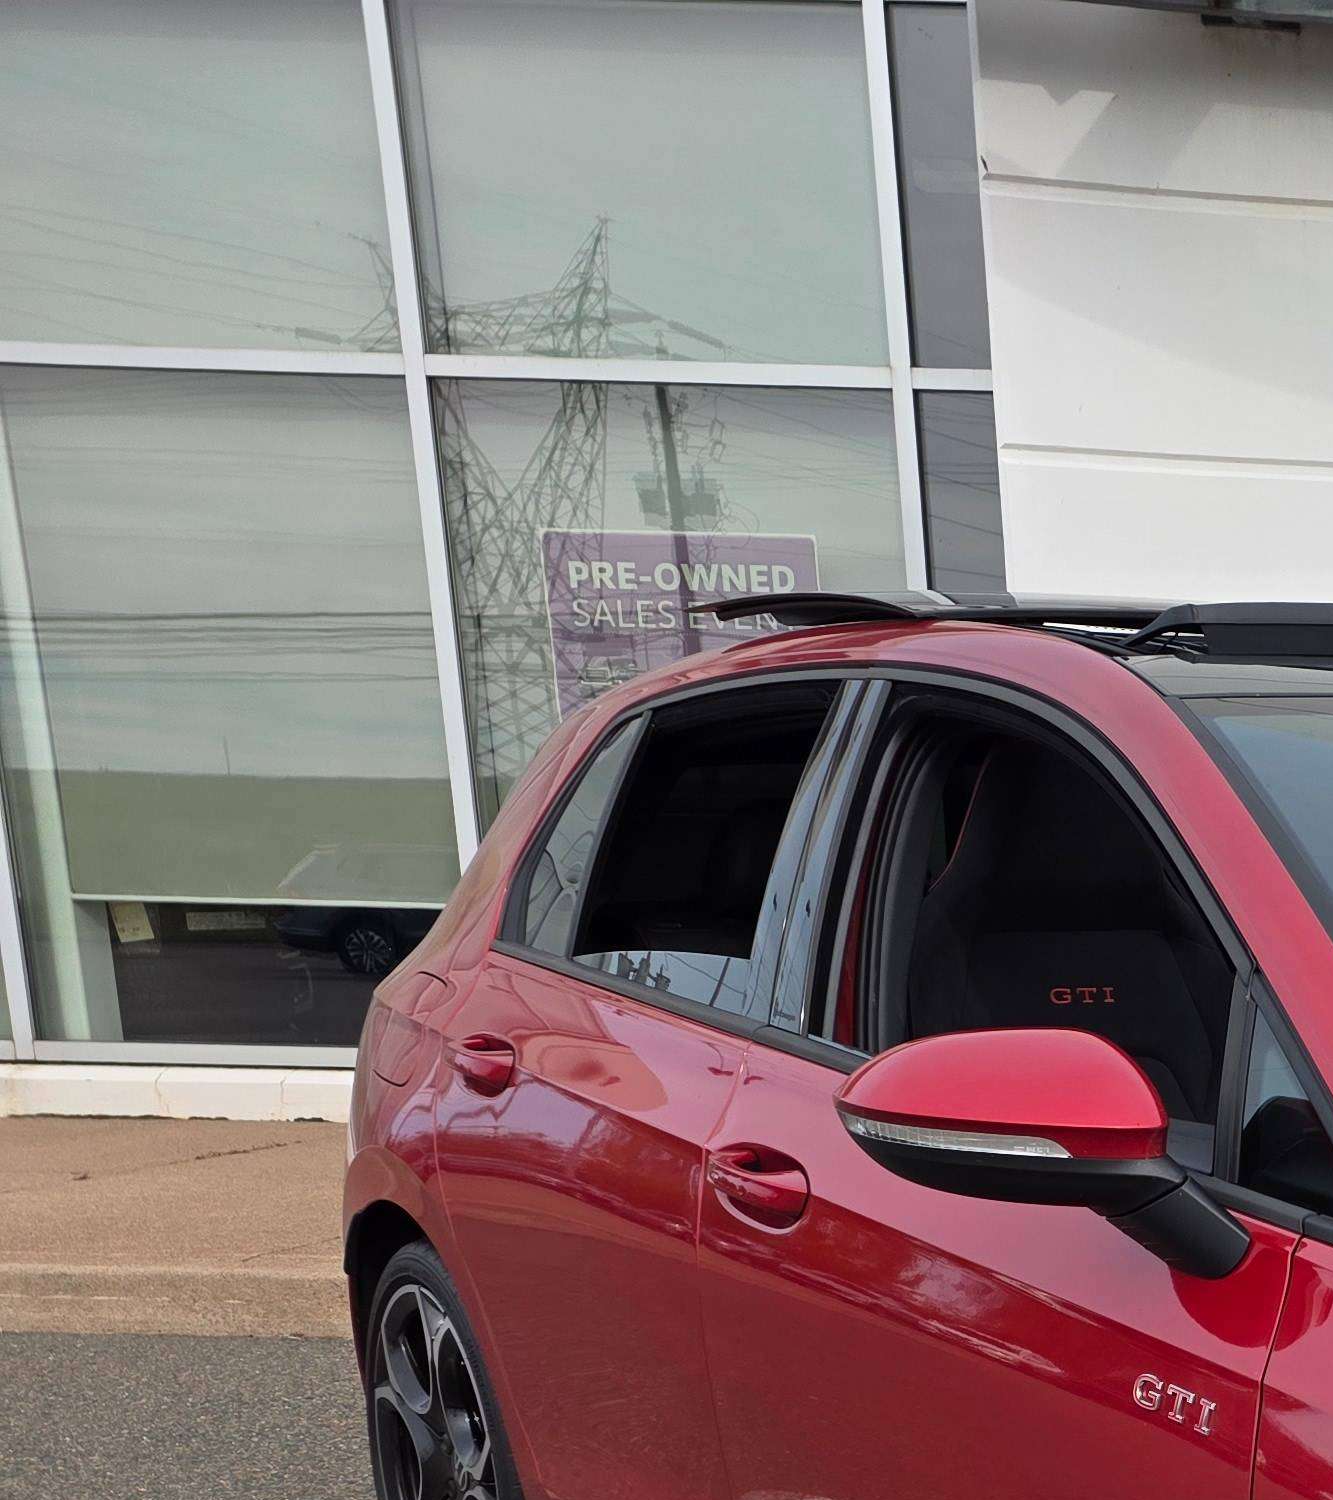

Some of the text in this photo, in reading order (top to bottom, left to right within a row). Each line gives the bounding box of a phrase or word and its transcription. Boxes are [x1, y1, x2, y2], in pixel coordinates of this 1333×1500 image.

[567, 561, 795, 593] PRE-OWNED
[573, 600, 676, 629] SALES
[1049, 987, 1115, 1004] GTI
[1132, 1373, 1217, 1436] GTI
